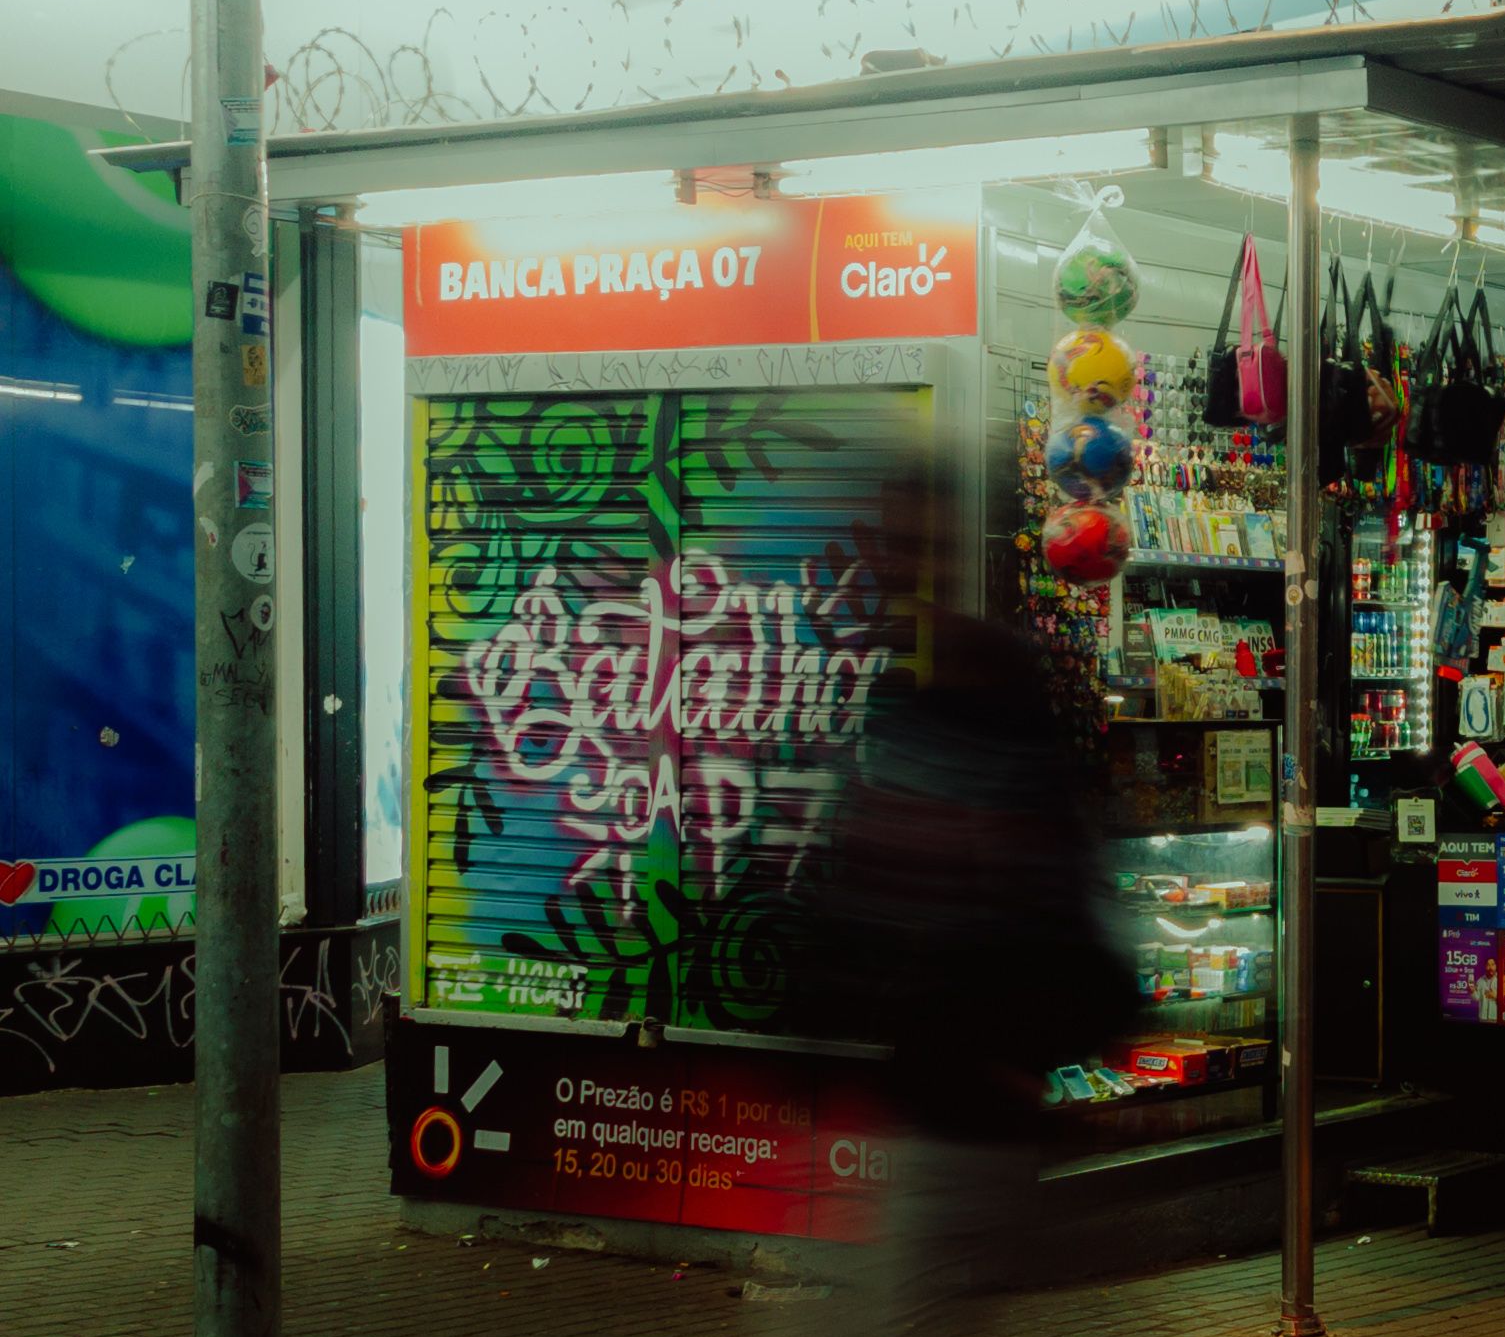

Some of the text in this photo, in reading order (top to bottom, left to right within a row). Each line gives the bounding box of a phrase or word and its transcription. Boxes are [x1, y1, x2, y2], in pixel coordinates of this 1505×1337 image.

[843, 230, 913, 249] AQUI TEM
[440, 246, 762, 301] BANCA PRAÇA 07
[841, 258, 937, 298] Claro
[1164, 627, 1195, 641] PMMG
[1197, 628, 1220, 643] CMG
[1440, 842, 1469, 853] AQUI
[1471, 842, 1495, 853] TEM
[39, 865, 145, 892] DROGA
[1464, 912, 1480, 922] TIM
[1446, 950, 1478, 965] 15GB
[555, 1077, 811, 1127] O Prezão é R$ 1 por dia
[553, 1118, 779, 1165] em qualquer recarga:
[553, 1147, 584, 1179] 15,
[589, 1151, 617, 1179] 20
[621, 1159, 650, 1181] ou
[655, 1158, 683, 1185] 30
[829, 1139, 893, 1182] Cla
